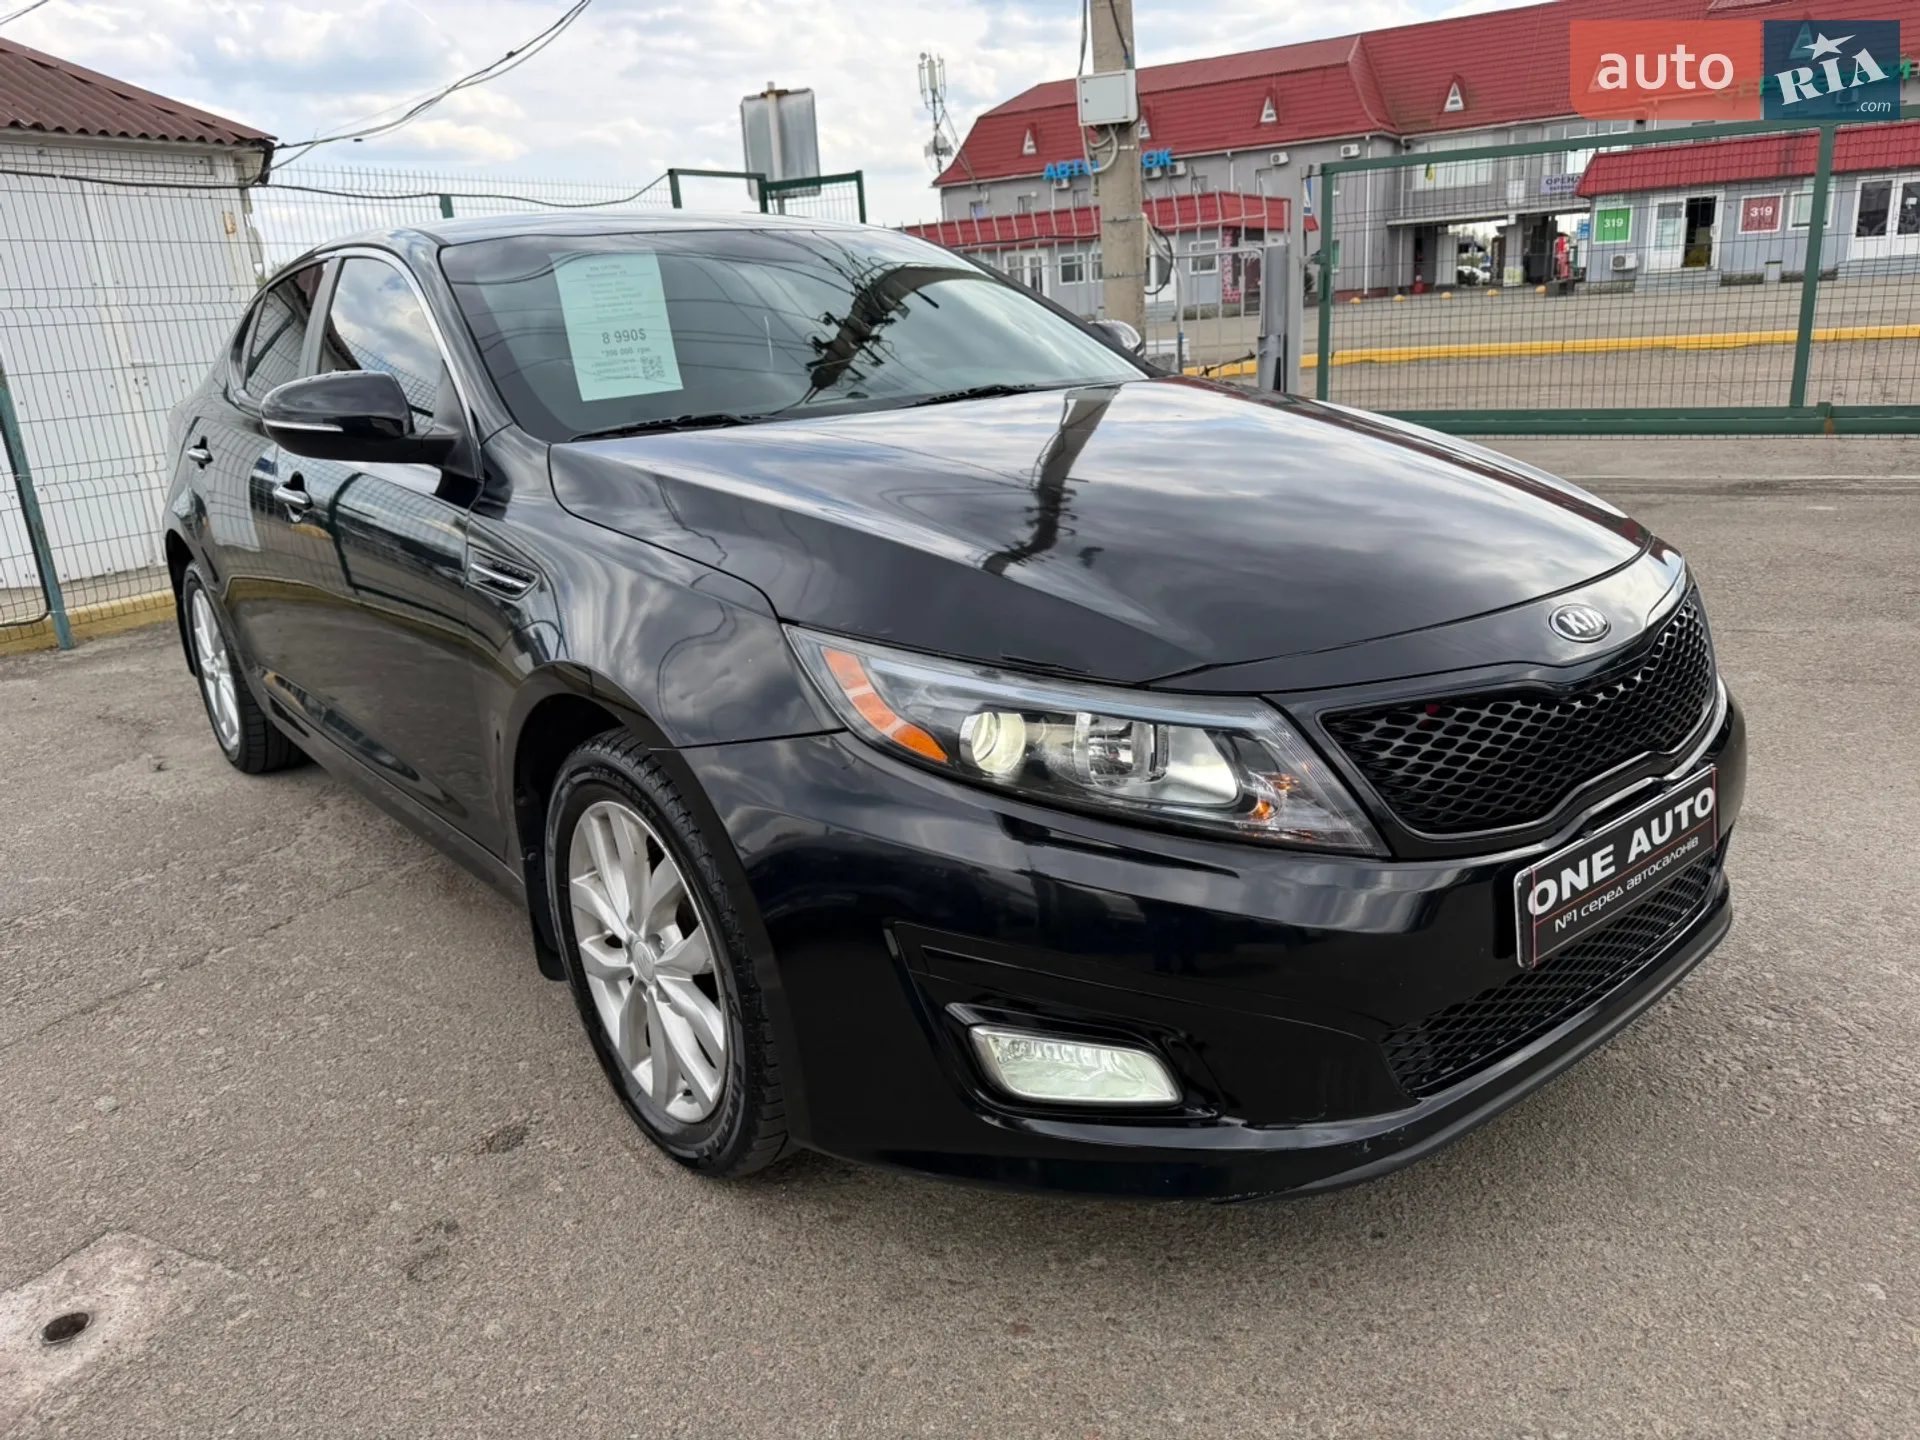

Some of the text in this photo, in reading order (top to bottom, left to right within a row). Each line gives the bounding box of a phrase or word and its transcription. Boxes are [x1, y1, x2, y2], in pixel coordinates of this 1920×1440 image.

[1749, 205, 1774, 218] 319
[1603, 217, 1625, 229] 319
[601, 327, 647, 345] 8 990$
[1527, 786, 1715, 916] ONE AUTO
[1554, 836, 1699, 933] №1 серед автосалонів
